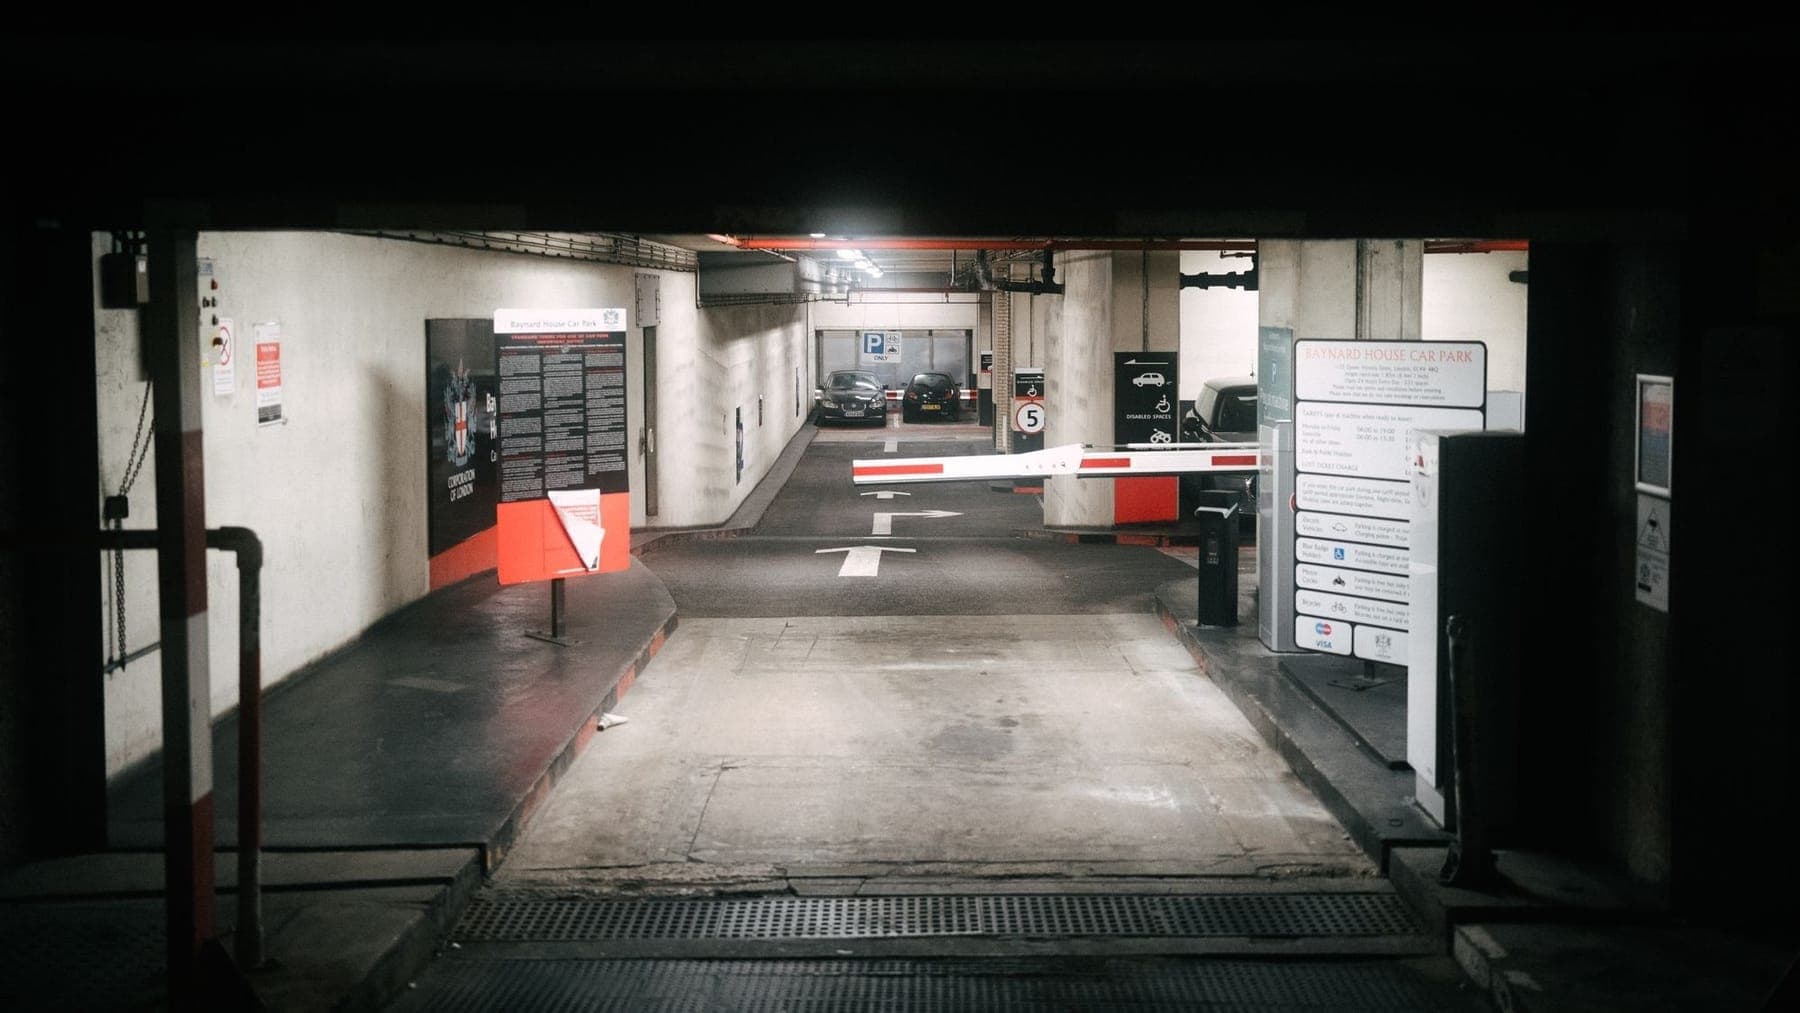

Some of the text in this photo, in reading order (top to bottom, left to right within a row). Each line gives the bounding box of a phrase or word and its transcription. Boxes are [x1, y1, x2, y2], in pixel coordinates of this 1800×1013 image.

[511, 319, 597, 329] Baynard House Car Park
[866, 334, 882, 353] P
[1304, 348, 1473, 362] BAYNARD HOUSE CAR PARK
[1027, 410, 1038, 428] 5
[1335, 463, 1358, 471] CHARGE
[448, 468, 476, 489] CORPORATION
[450, 482, 474, 502] OF LONDON
[1355, 530, 1375, 539] Charging
[1354, 550, 1372, 558] Parking
[1316, 640, 1333, 649] VISA
